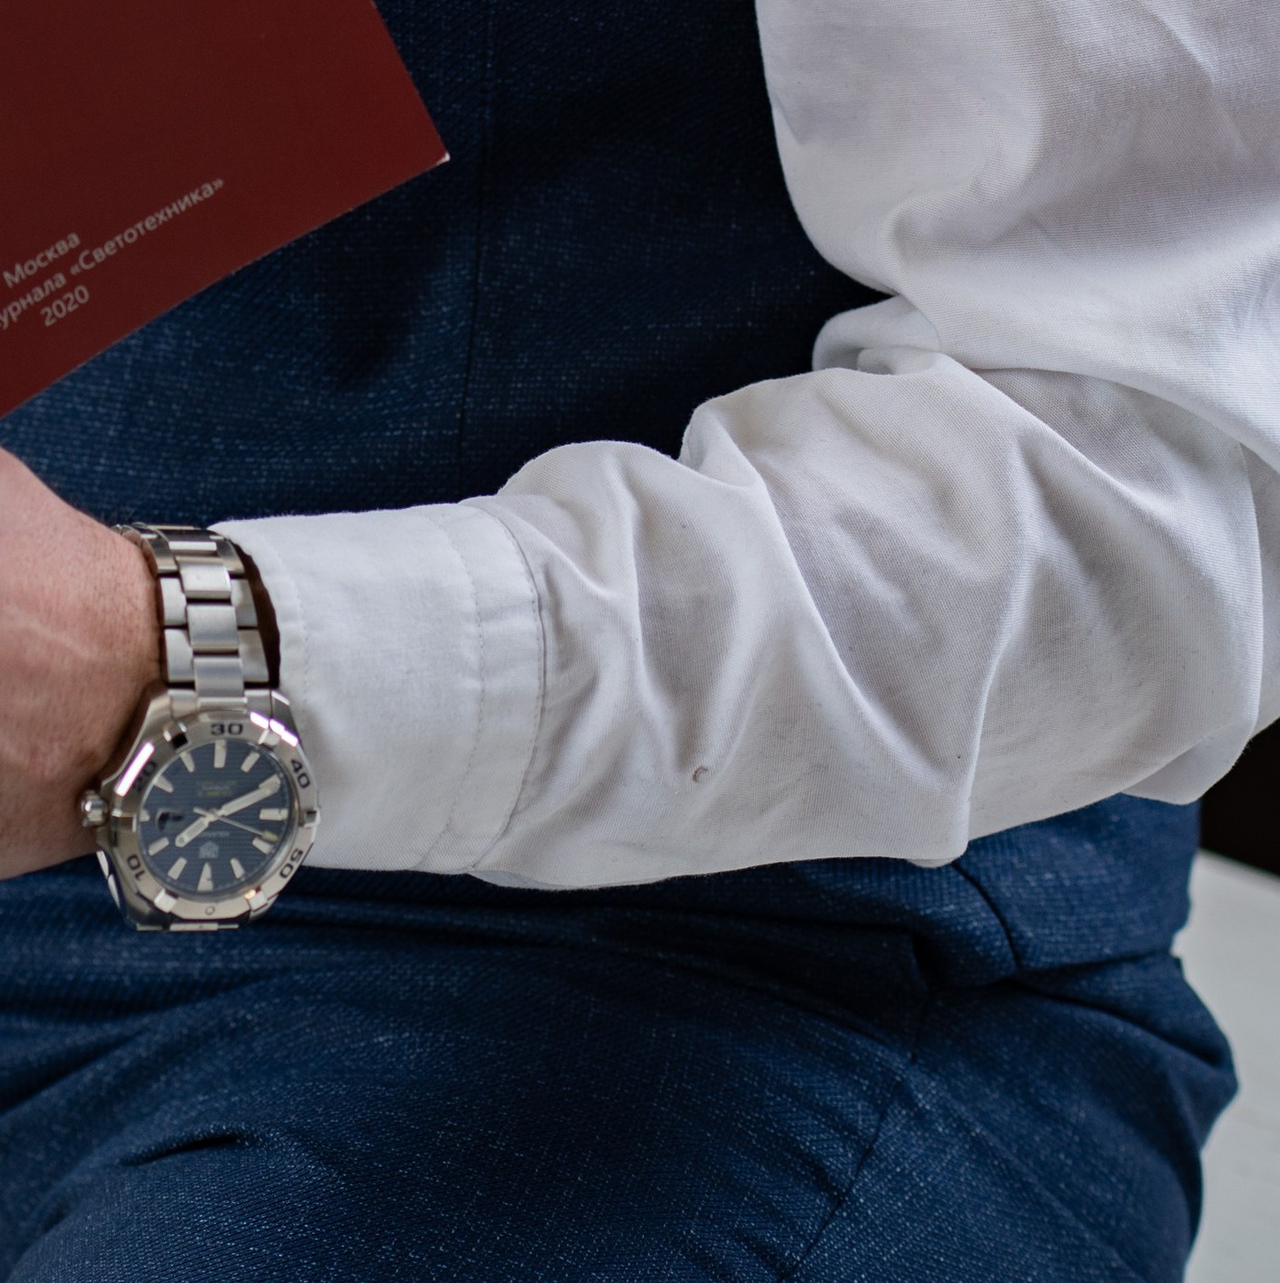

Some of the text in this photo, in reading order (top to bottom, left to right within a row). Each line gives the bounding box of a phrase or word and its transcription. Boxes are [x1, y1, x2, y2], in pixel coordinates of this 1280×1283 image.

[69, 178, 225, 277] «Светотехника»
[2, 232, 81, 288] Москва
[39, 284, 91, 328] 2020
[210, 722, 244, 737] 30
[290, 758, 311, 790] 40
[126, 854, 144, 881] 10
[280, 849, 303, 879] 50
